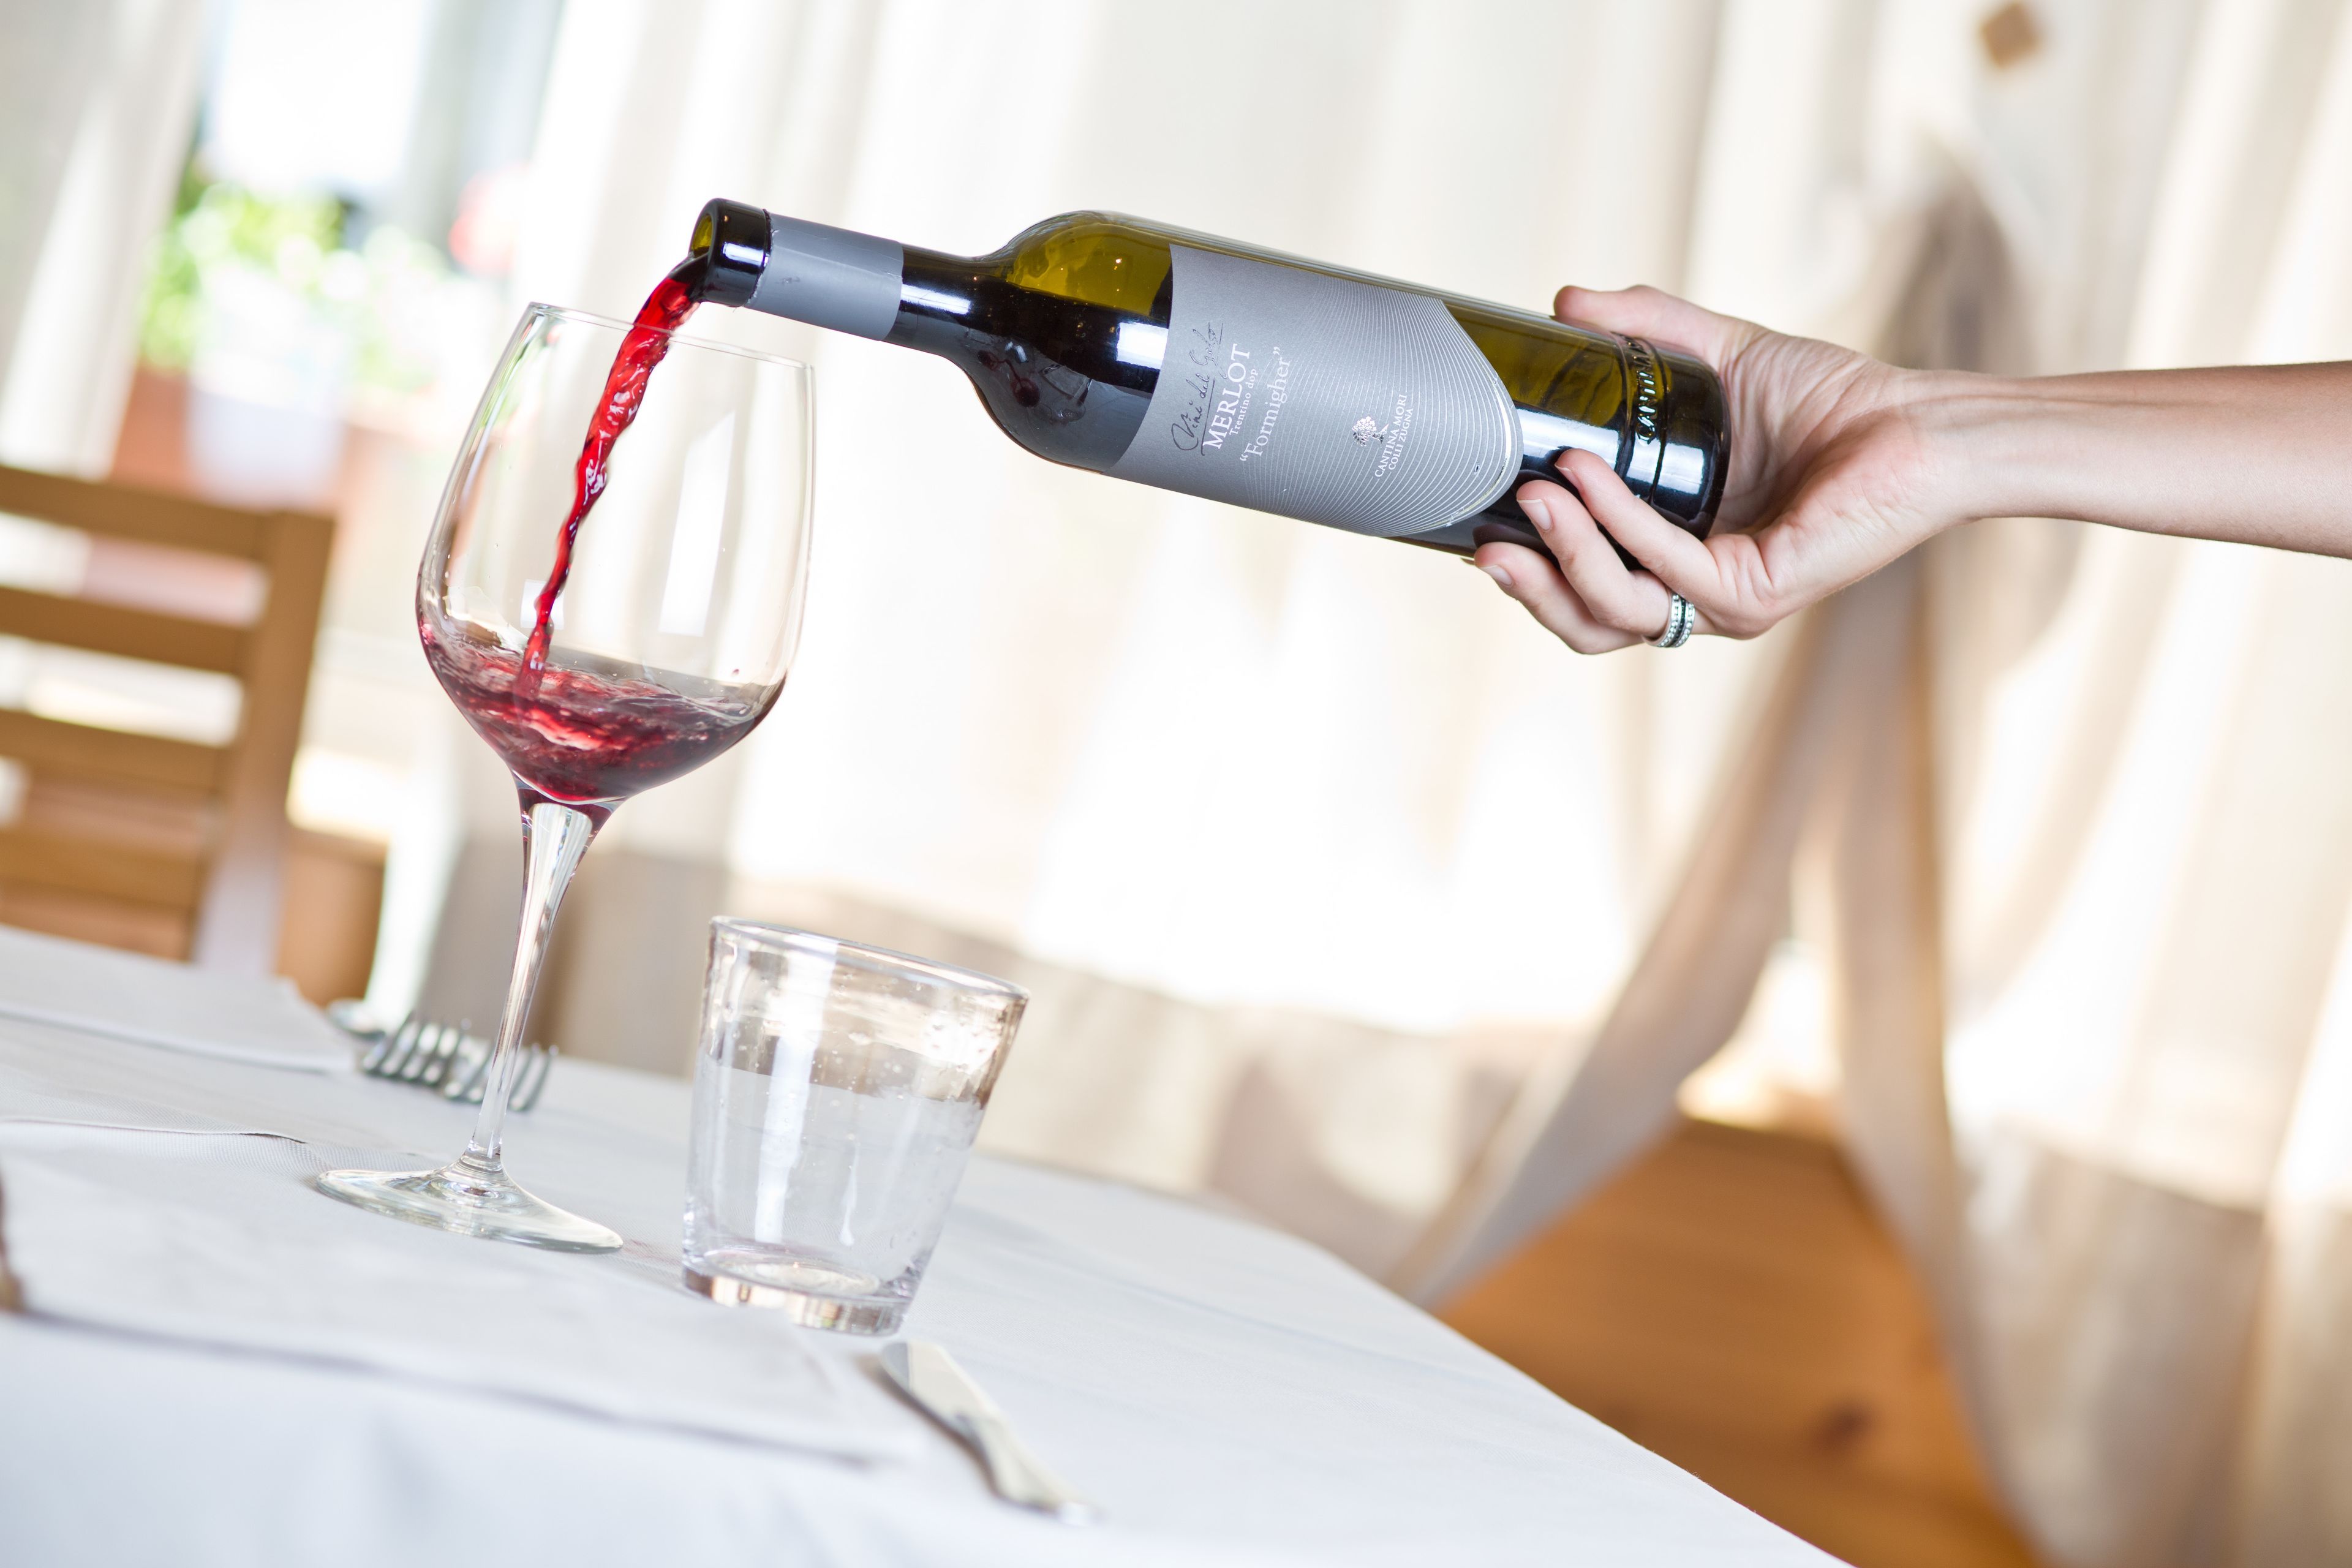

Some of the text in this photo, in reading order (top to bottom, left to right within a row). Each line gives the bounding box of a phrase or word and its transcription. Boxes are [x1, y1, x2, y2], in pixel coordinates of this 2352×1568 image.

[1202, 343, 1250, 450] MERLOT
[1229, 368, 1259, 435] Trentino dop
[1374, 394, 1408, 478] CANTINA MORI
[1388, 408, 1414, 470] COLLI ZUGNA
